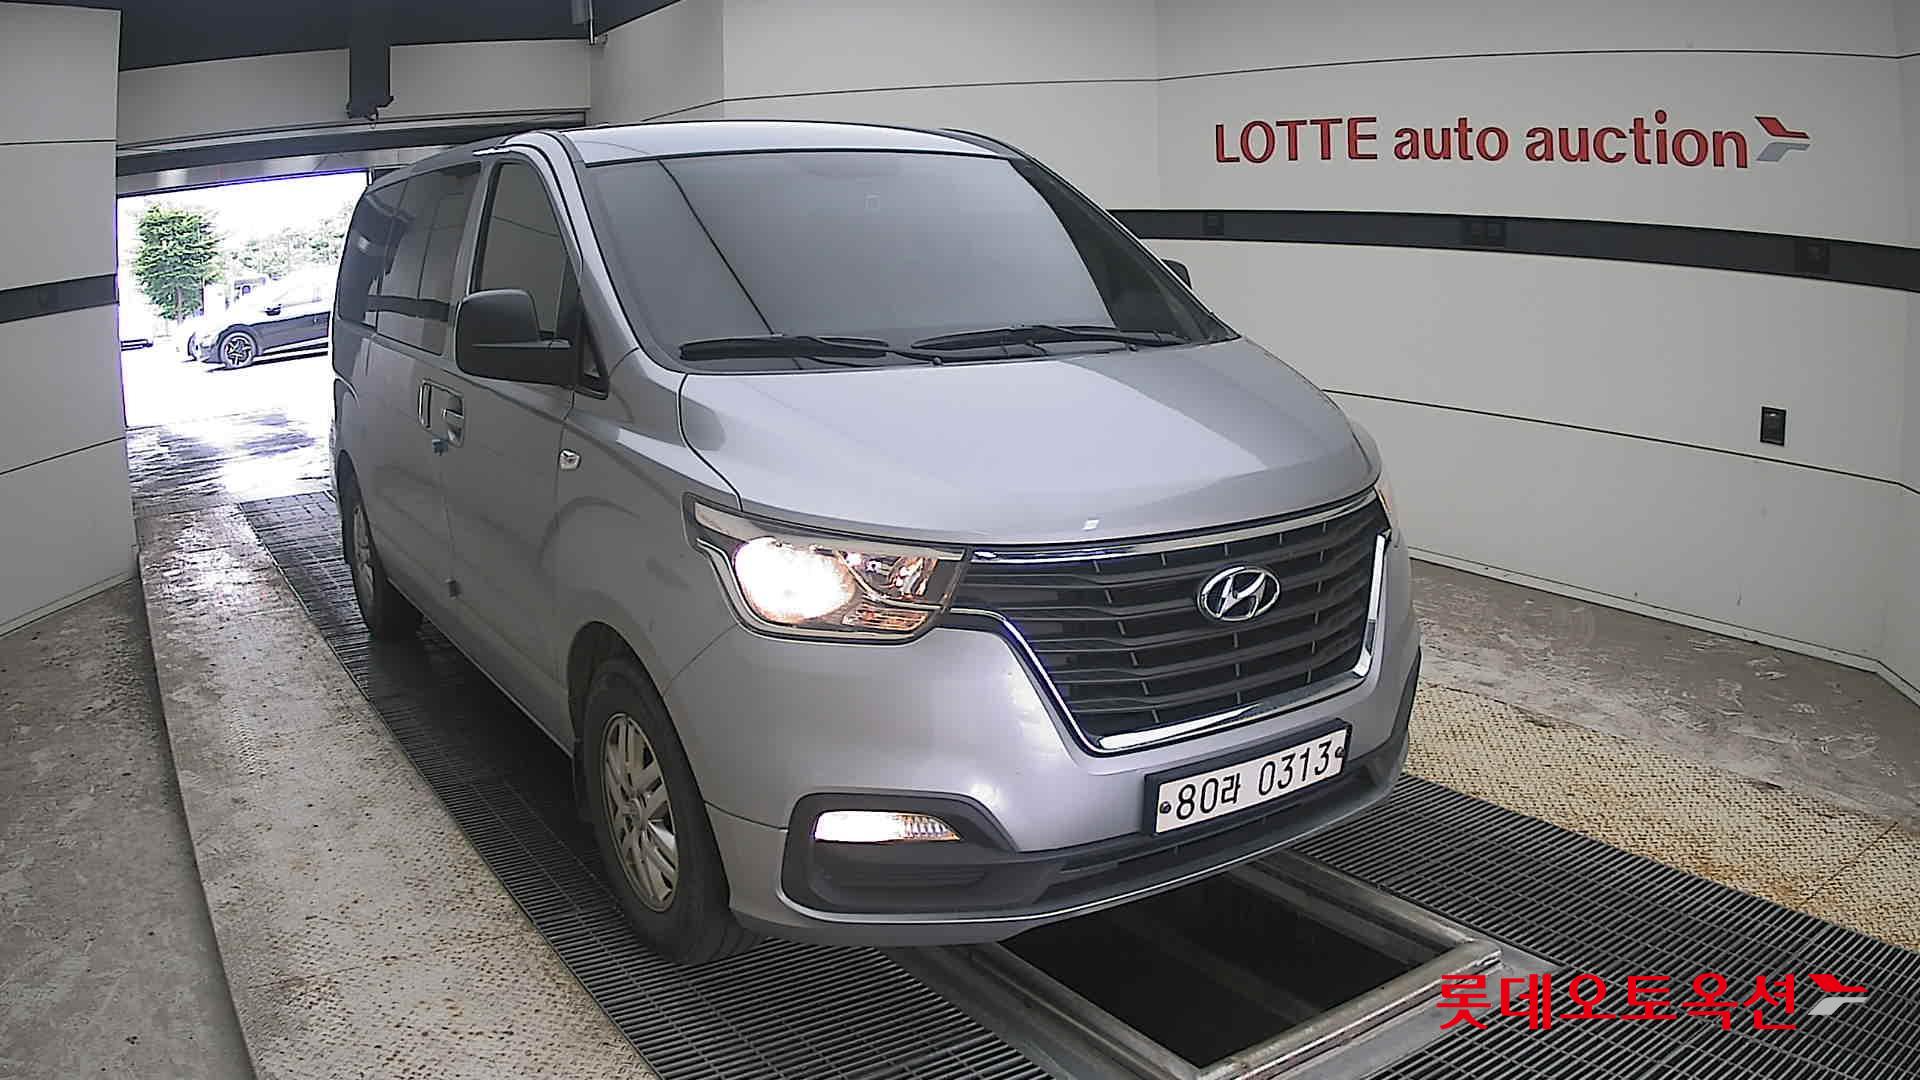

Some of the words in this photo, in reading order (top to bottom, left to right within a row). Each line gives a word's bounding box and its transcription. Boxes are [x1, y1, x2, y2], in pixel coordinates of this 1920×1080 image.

[1215, 116, 1377, 164] LOTTE
[1393, 117, 1509, 162] auto
[1525, 110, 1748, 168] auction
[1176, 773, 1241, 820] 80라
[1258, 740, 1332, 796] 0313
